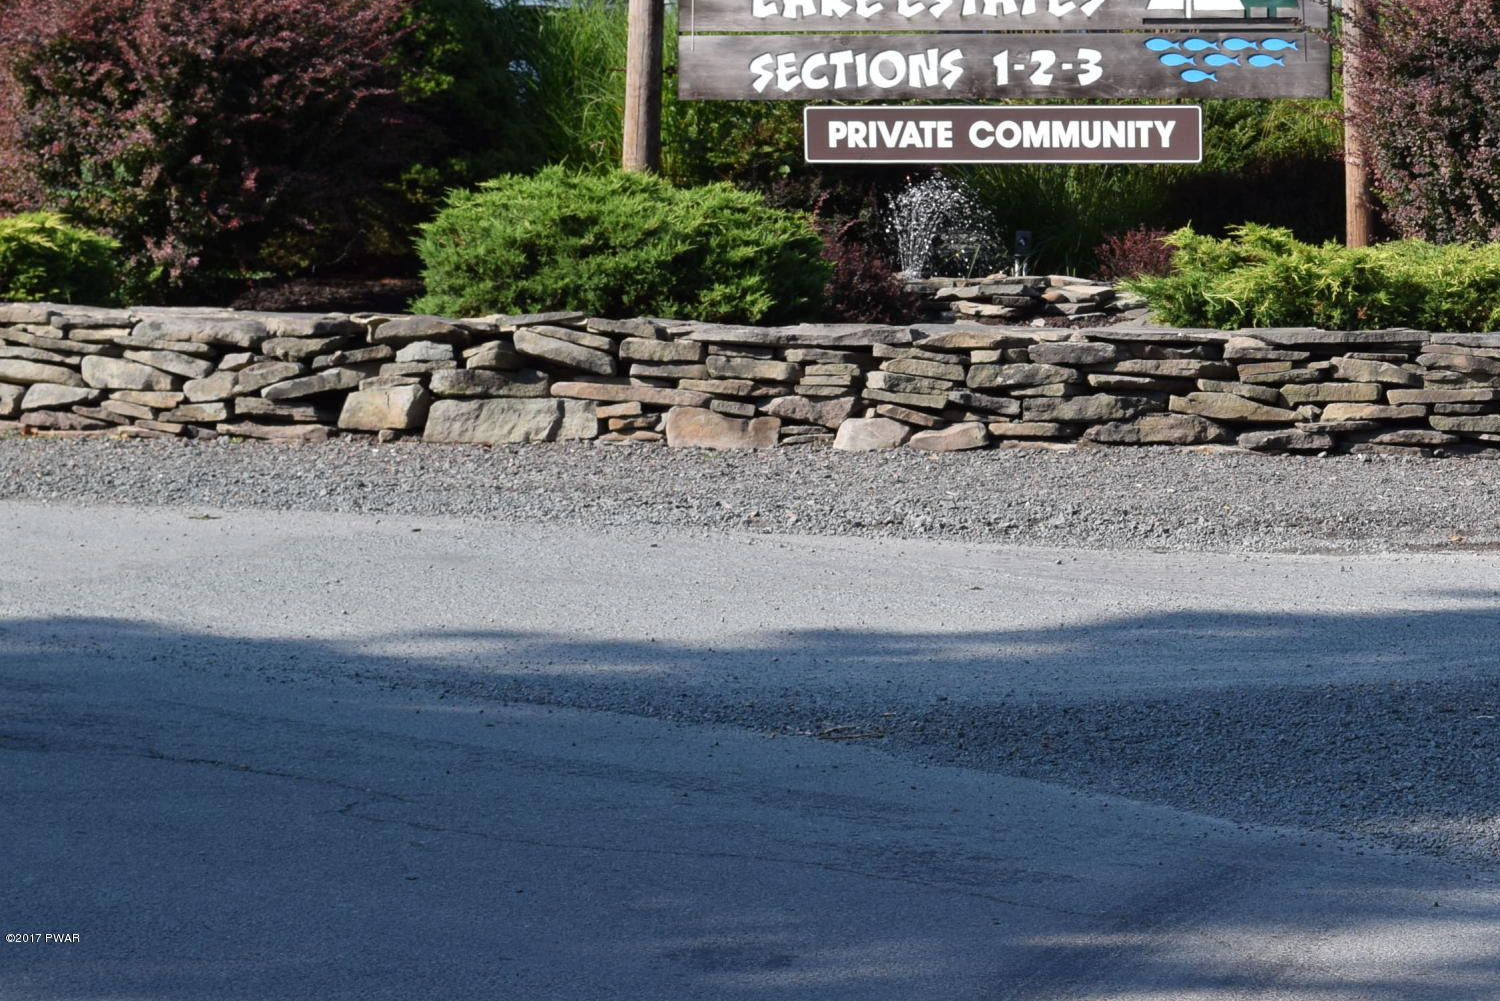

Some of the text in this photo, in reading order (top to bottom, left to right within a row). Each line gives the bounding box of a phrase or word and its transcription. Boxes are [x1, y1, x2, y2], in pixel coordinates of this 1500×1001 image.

[749, 48, 1104, 93] SECTIONS 1-2-3
[828, 120, 1176, 149] PRIVATE COMMUNITY
